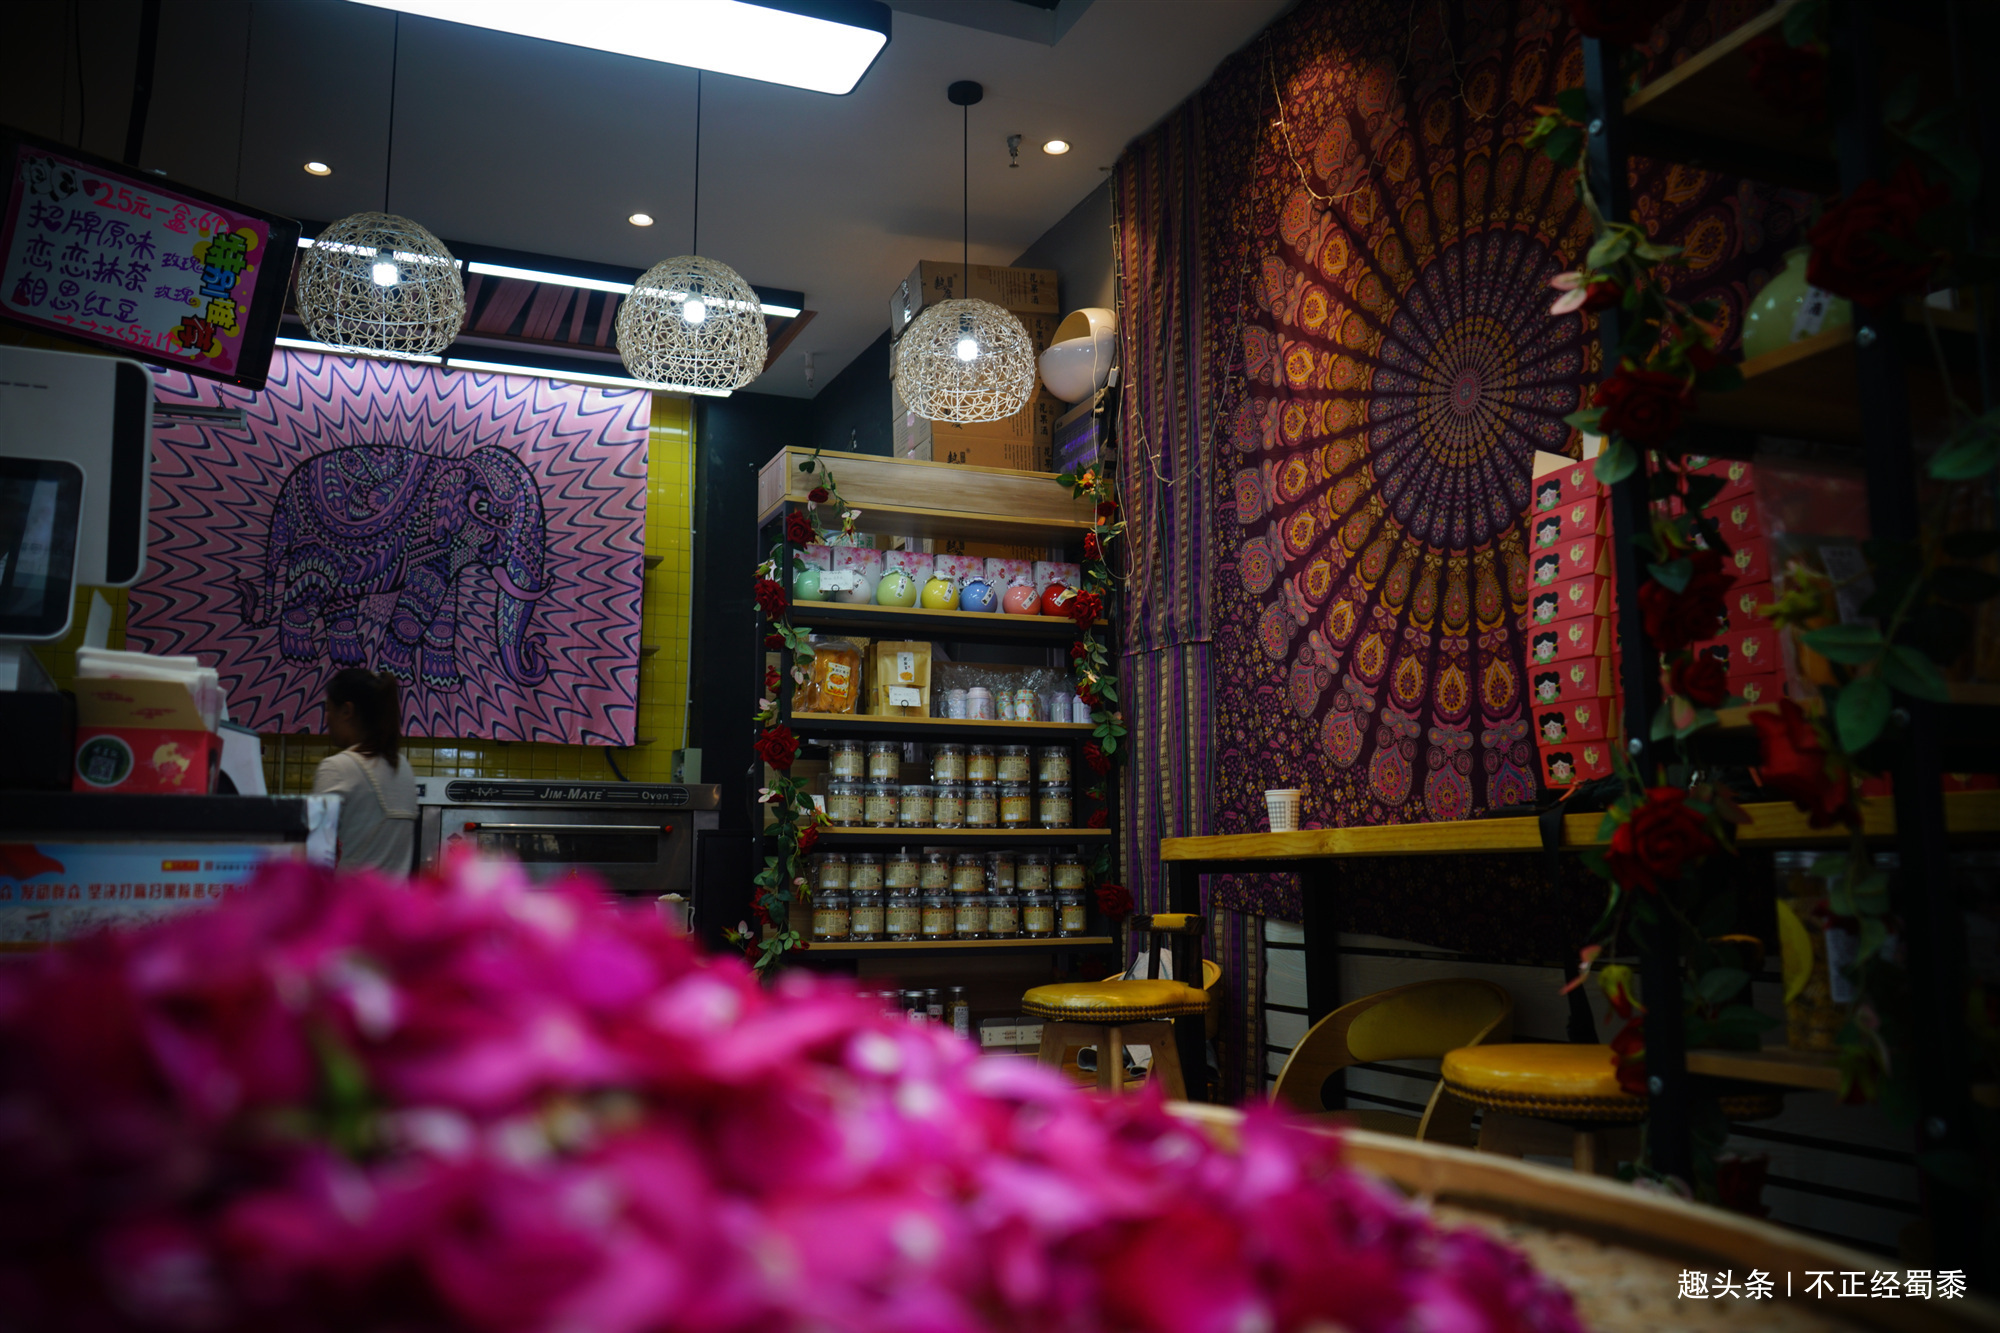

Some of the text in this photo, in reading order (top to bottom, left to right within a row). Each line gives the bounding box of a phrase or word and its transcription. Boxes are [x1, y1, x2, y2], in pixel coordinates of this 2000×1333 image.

[27, 200, 156, 260] 招牌原味
[22, 234, 152, 293] 恋恋抹茶
[641, 792, 669, 801] Oven
